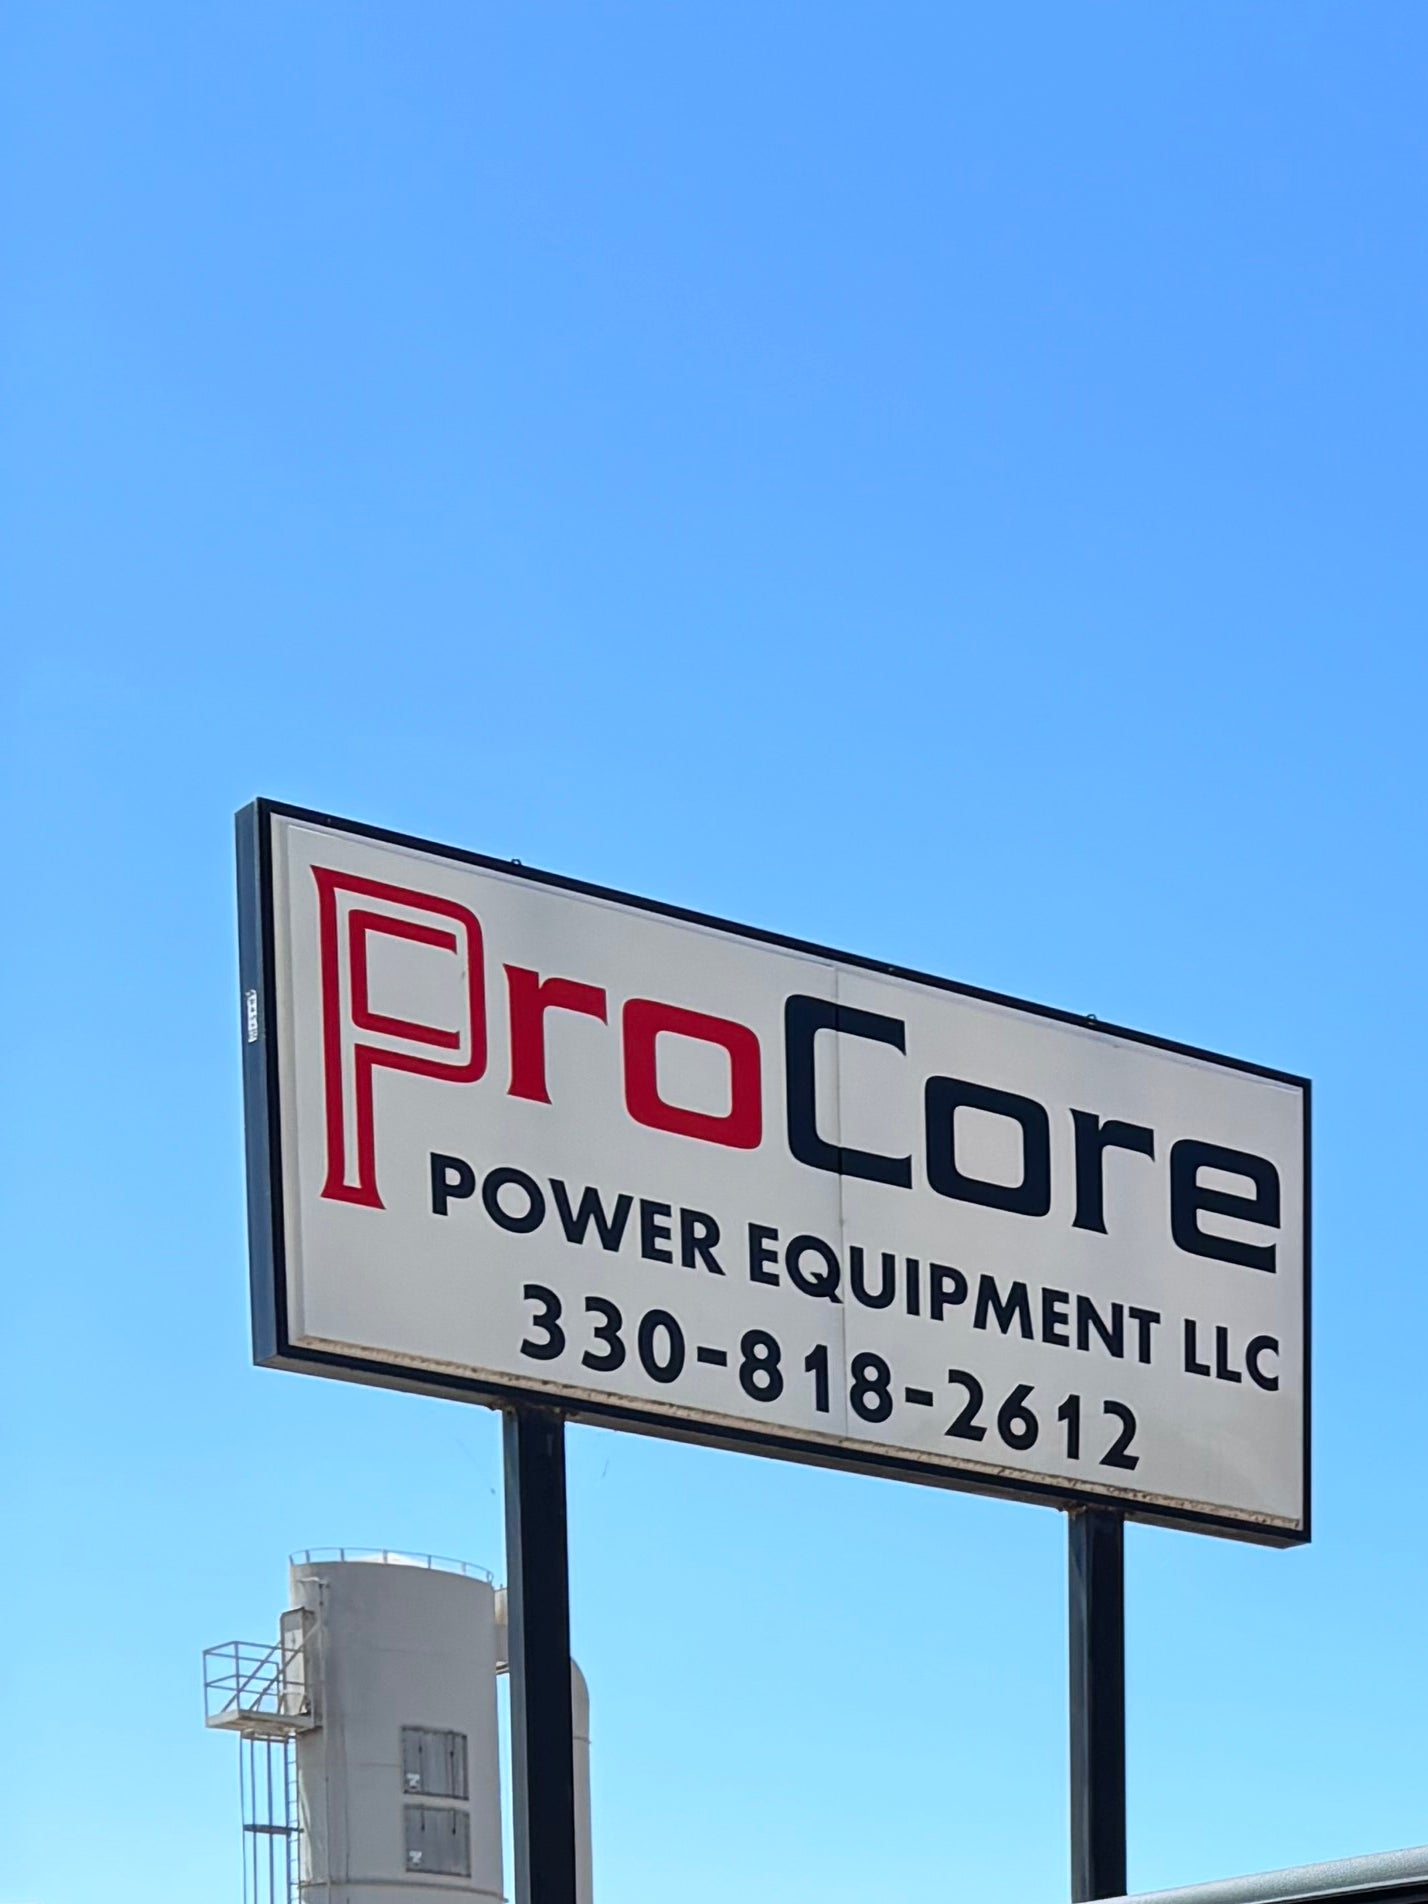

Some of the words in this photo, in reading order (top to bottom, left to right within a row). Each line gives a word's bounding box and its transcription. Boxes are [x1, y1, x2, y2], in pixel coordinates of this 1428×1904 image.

[310, 865, 1282, 1274] ProCore
[430, 1152, 727, 1277] POWER
[748, 1221, 1162, 1365] EQUIPMENT
[1184, 1317, 1280, 1392] LLC
[520, 1283, 1140, 1472] 330-818-2612
